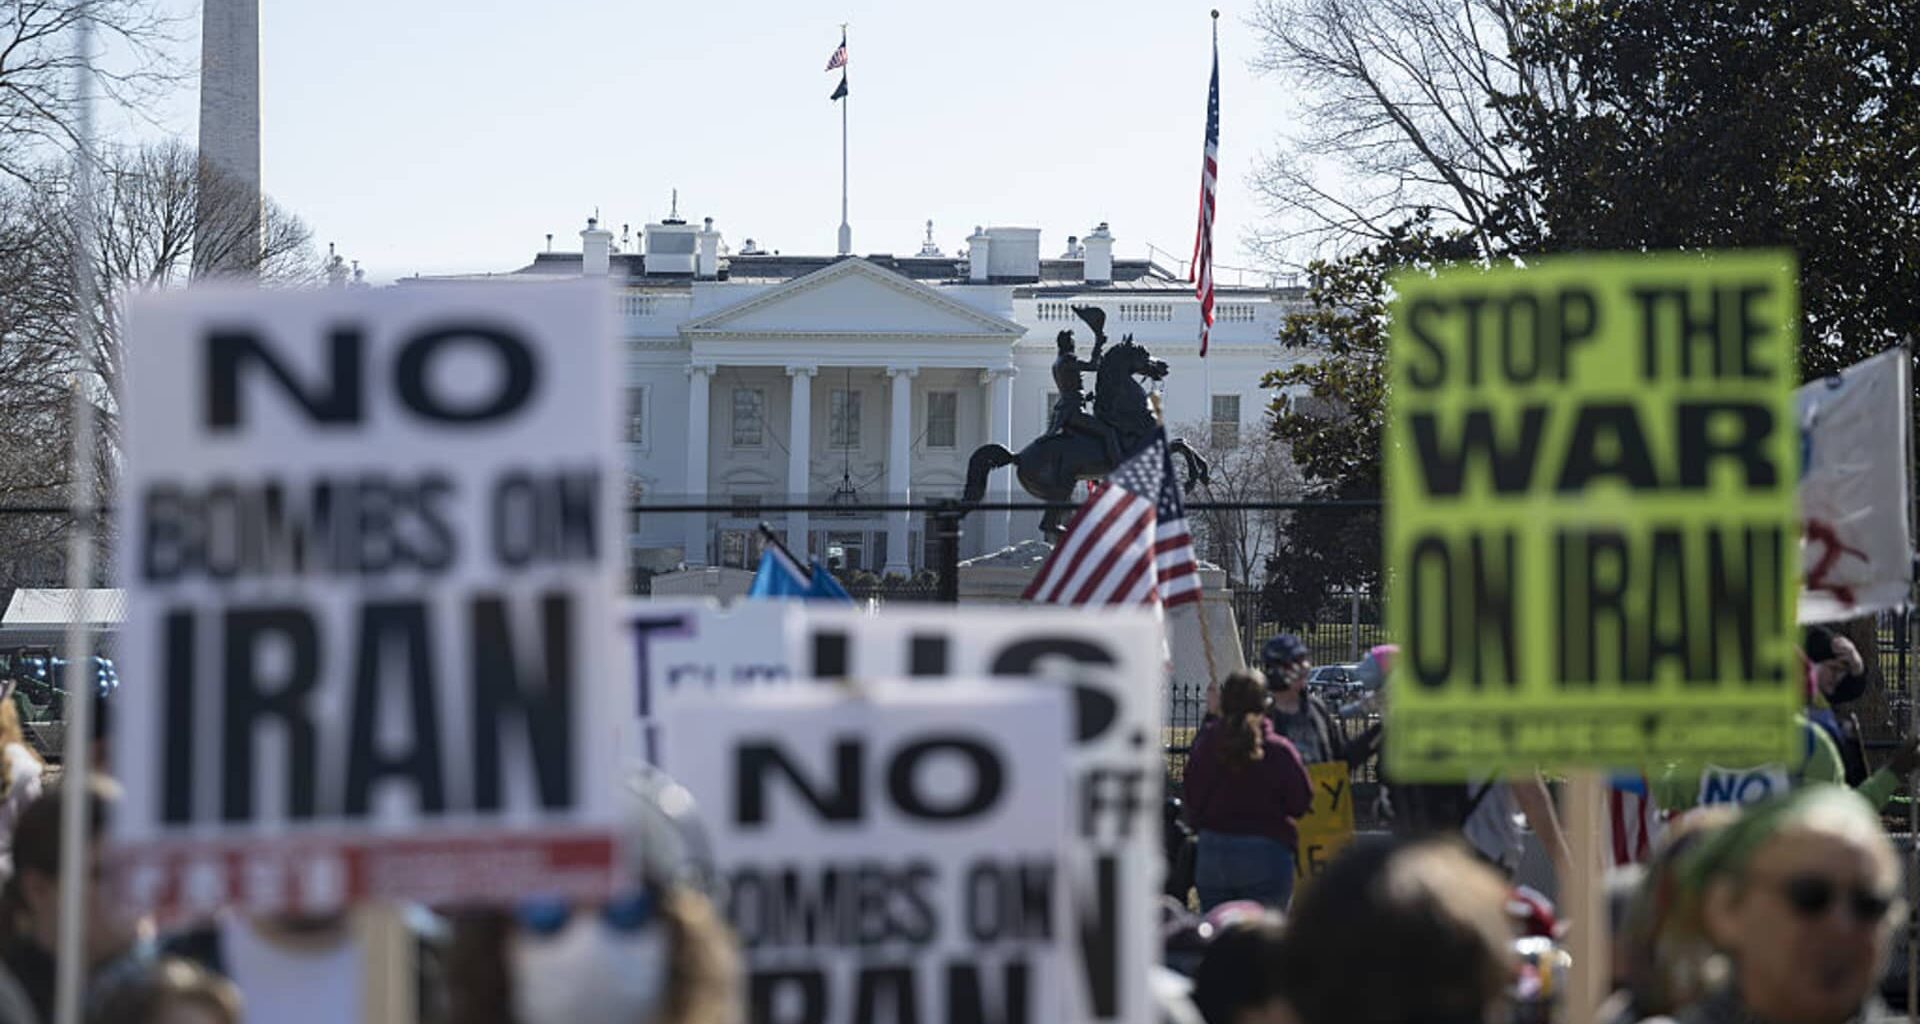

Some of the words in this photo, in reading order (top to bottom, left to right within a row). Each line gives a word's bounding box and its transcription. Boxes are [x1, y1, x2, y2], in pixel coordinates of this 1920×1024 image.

[203, 322, 540, 430] NO
[1406, 288, 1600, 390] STOP
[1629, 280, 1777, 384] THE
[1408, 400, 1779, 497] WAR
[142, 470, 456, 583] BOMBS
[492, 465, 603, 567] ON
[1408, 530, 1517, 690] ON
[1555, 523, 1785, 686] IRAN!
[160, 590, 578, 826] IRAN
[733, 736, 1007, 826] NO
[1079, 767, 1148, 839] FF
[1703, 769, 1773, 805] NO
[728, 860, 936, 947] OMBS
[964, 859, 1056, 944] ON
